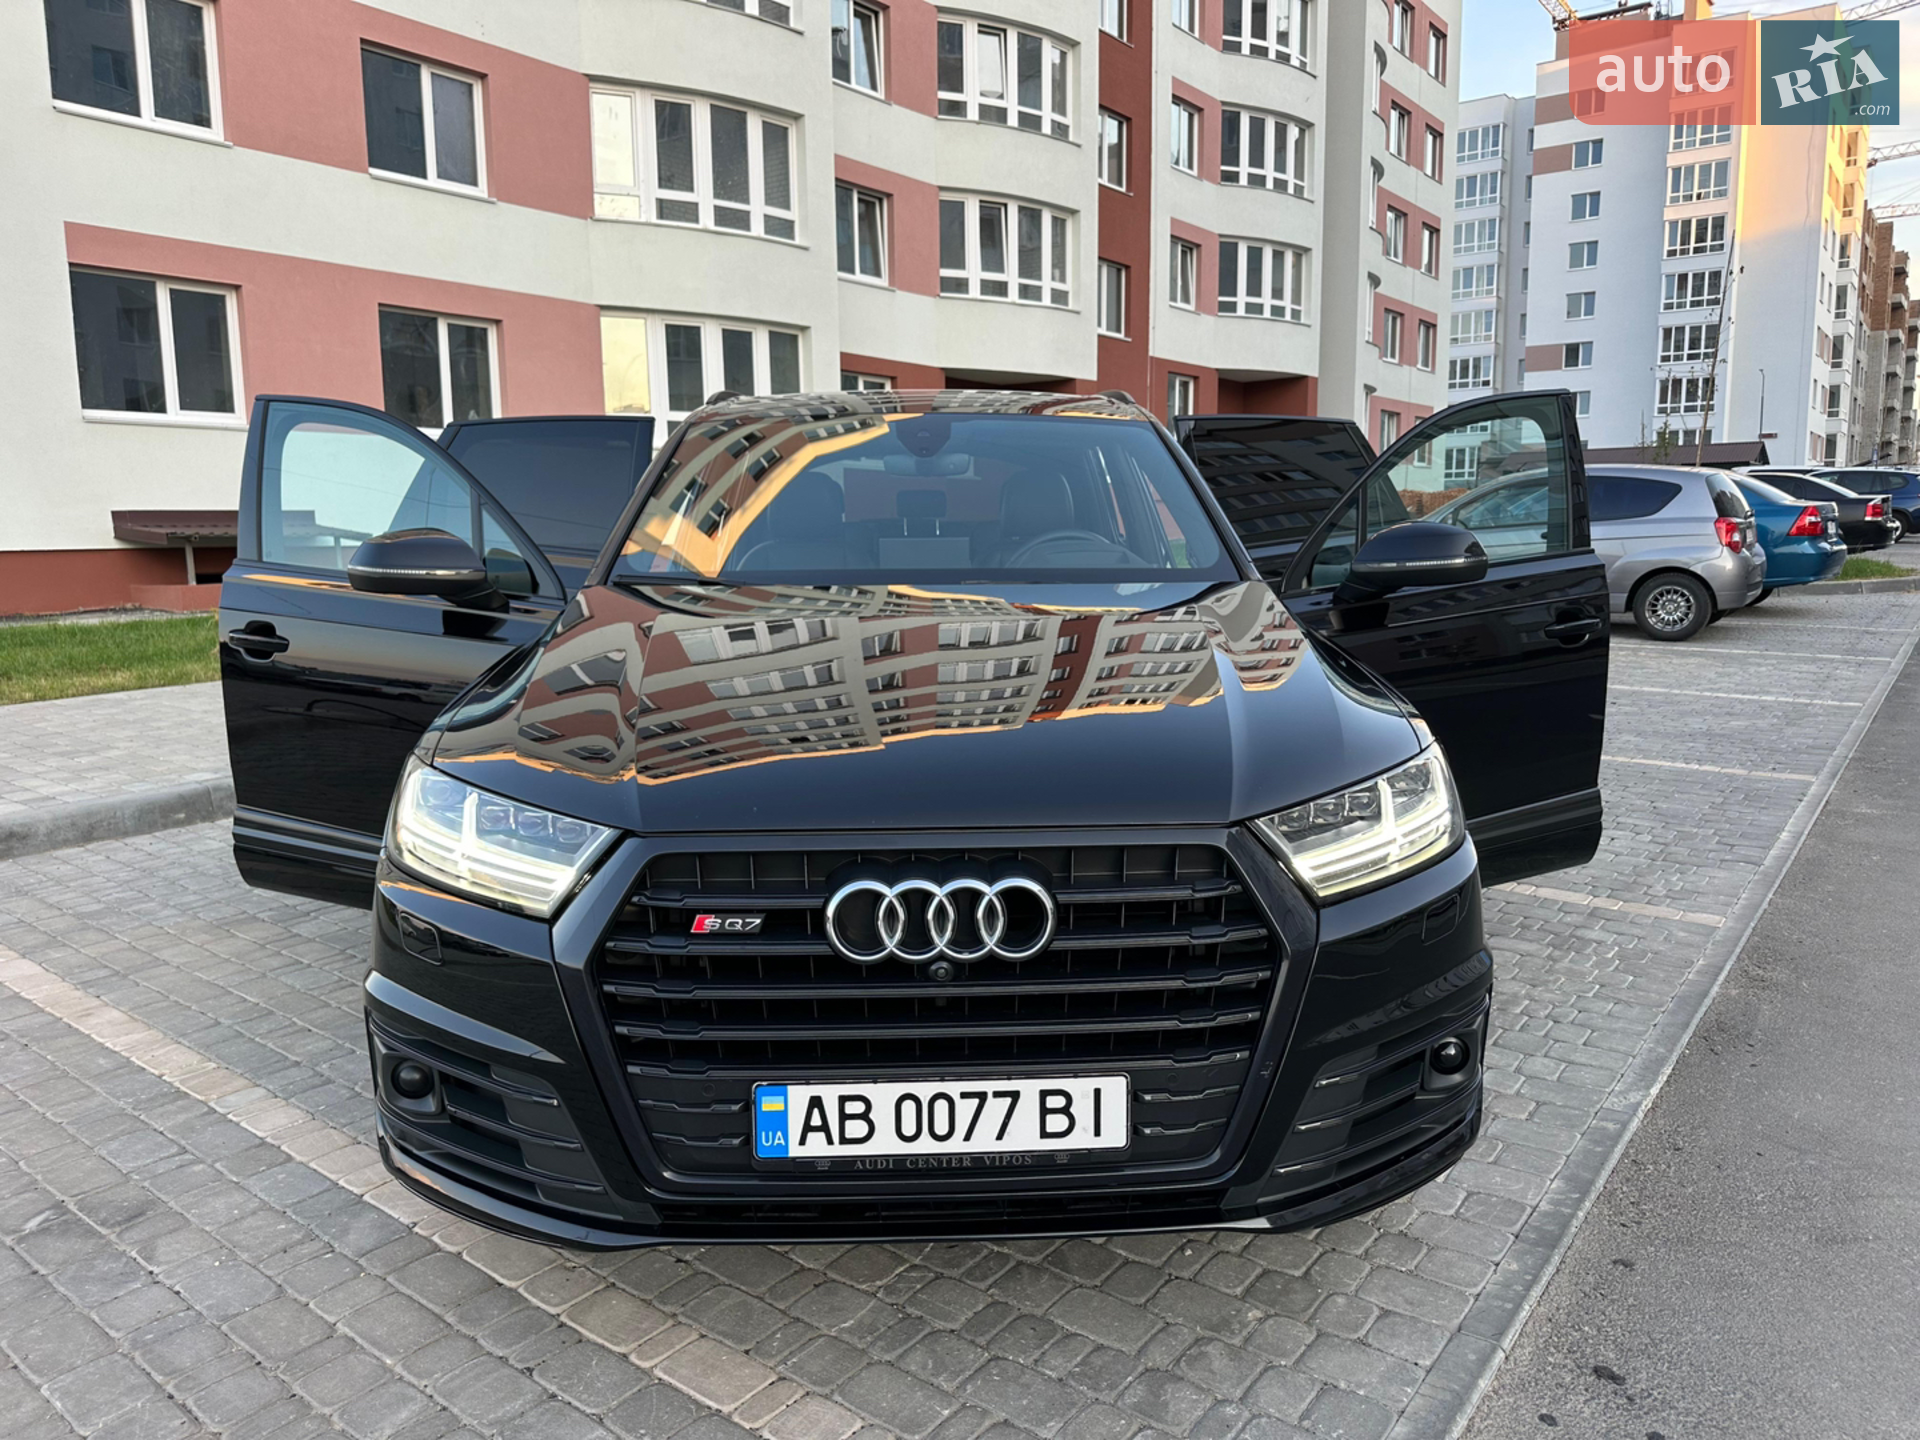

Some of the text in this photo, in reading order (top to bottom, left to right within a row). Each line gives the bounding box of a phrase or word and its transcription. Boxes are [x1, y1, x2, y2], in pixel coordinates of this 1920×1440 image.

[702, 918, 762, 931] SQ7
[798, 1087, 1102, 1146] AB 0077 BI
[761, 1130, 786, 1147] UA
[854, 1154, 1032, 1170] AUDI CENTER VIPOS
